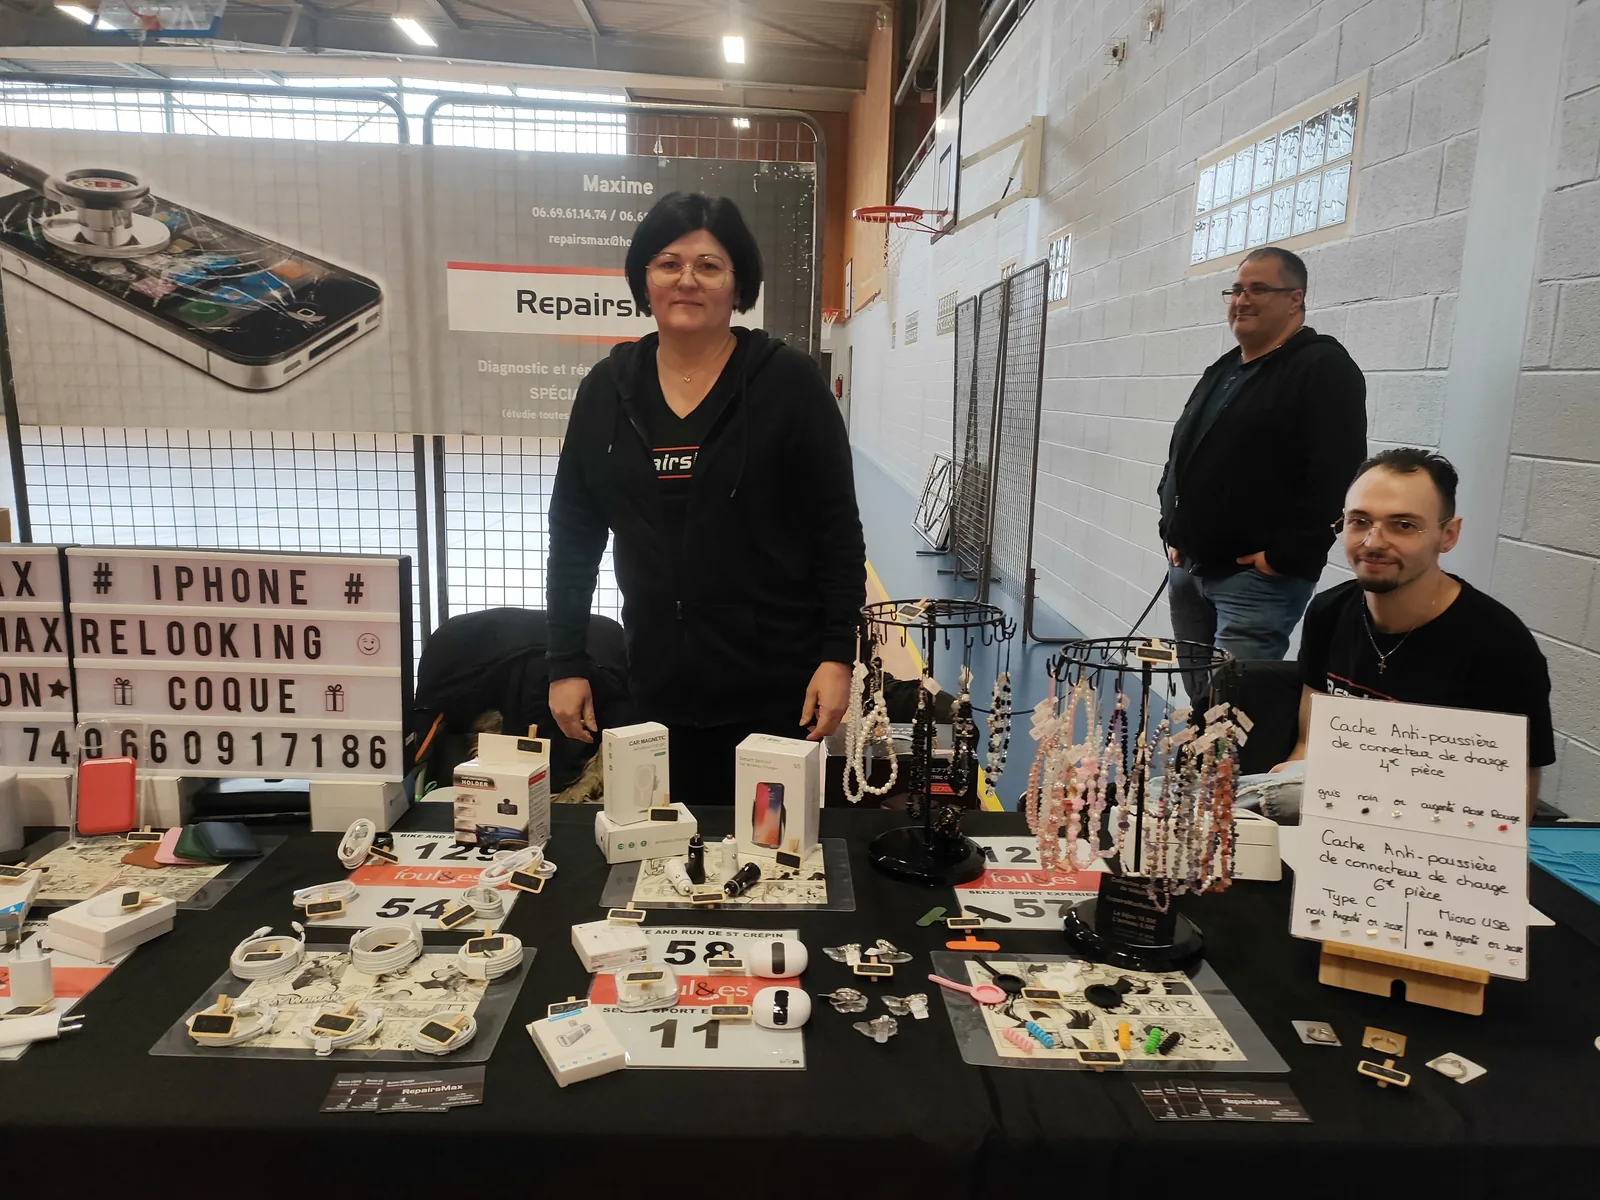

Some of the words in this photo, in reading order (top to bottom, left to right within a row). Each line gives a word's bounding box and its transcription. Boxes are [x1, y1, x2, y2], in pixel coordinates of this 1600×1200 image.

[583, 174, 654, 195] Maxime
[532, 207, 607, 221] 06.69.61.14.74
[478, 359, 549, 376] Diagnostic
[553, 364, 566, 375] et
[502, 409, 537, 420] (étudie
[540, 410, 570, 420] toutes
[0, 561, 35, 597] X
[93, 562, 113, 595] #
[153, 564, 308, 606] IPHONE
[344, 573, 364, 605] #
[81, 617, 322, 661] RELOOKING
[168, 676, 296, 714] COQUE
[1330, 715, 1377, 736] Cache
[640, 735, 666, 744] MAGNETIC
[1332, 735, 1353, 750] de
[1359, 743, 1433, 759] connecteur
[1439, 749, 1459, 763] de
[1464, 751, 1510, 772] charge
[1411, 763, 1447, 778] pièce
[461, 779, 489, 788] HOLDER
[1318, 788, 1341, 800] gris
[1357, 794, 1379, 803] noir
[1420, 801, 1456, 814] argenté
[1462, 806, 1485, 817] Rose
[1490, 809, 1521, 825] Rouge
[1321, 829, 1365, 851] Cache
[1319, 850, 1338, 865] de
[1345, 860, 1422, 879] connecteur
[1428, 870, 1447, 883] de
[1456, 874, 1510, 896] charge
[1322, 887, 1358, 906] Type
[1366, 896, 1377, 907] C
[1404, 885, 1443, 902] pièce
[376, 897, 451, 919] 54
[1013, 898, 1074, 918] 57
[1439, 909, 1476, 925] Micro
[1482, 917, 1510, 931] USB
[663, 940, 736, 966] 58
[1488, 941, 1500, 950] or
[650, 1018, 721, 1049] 11
[402, 1084, 463, 1095] RepairsMax
[1221, 1098, 1281, 1106] RepairsMax
